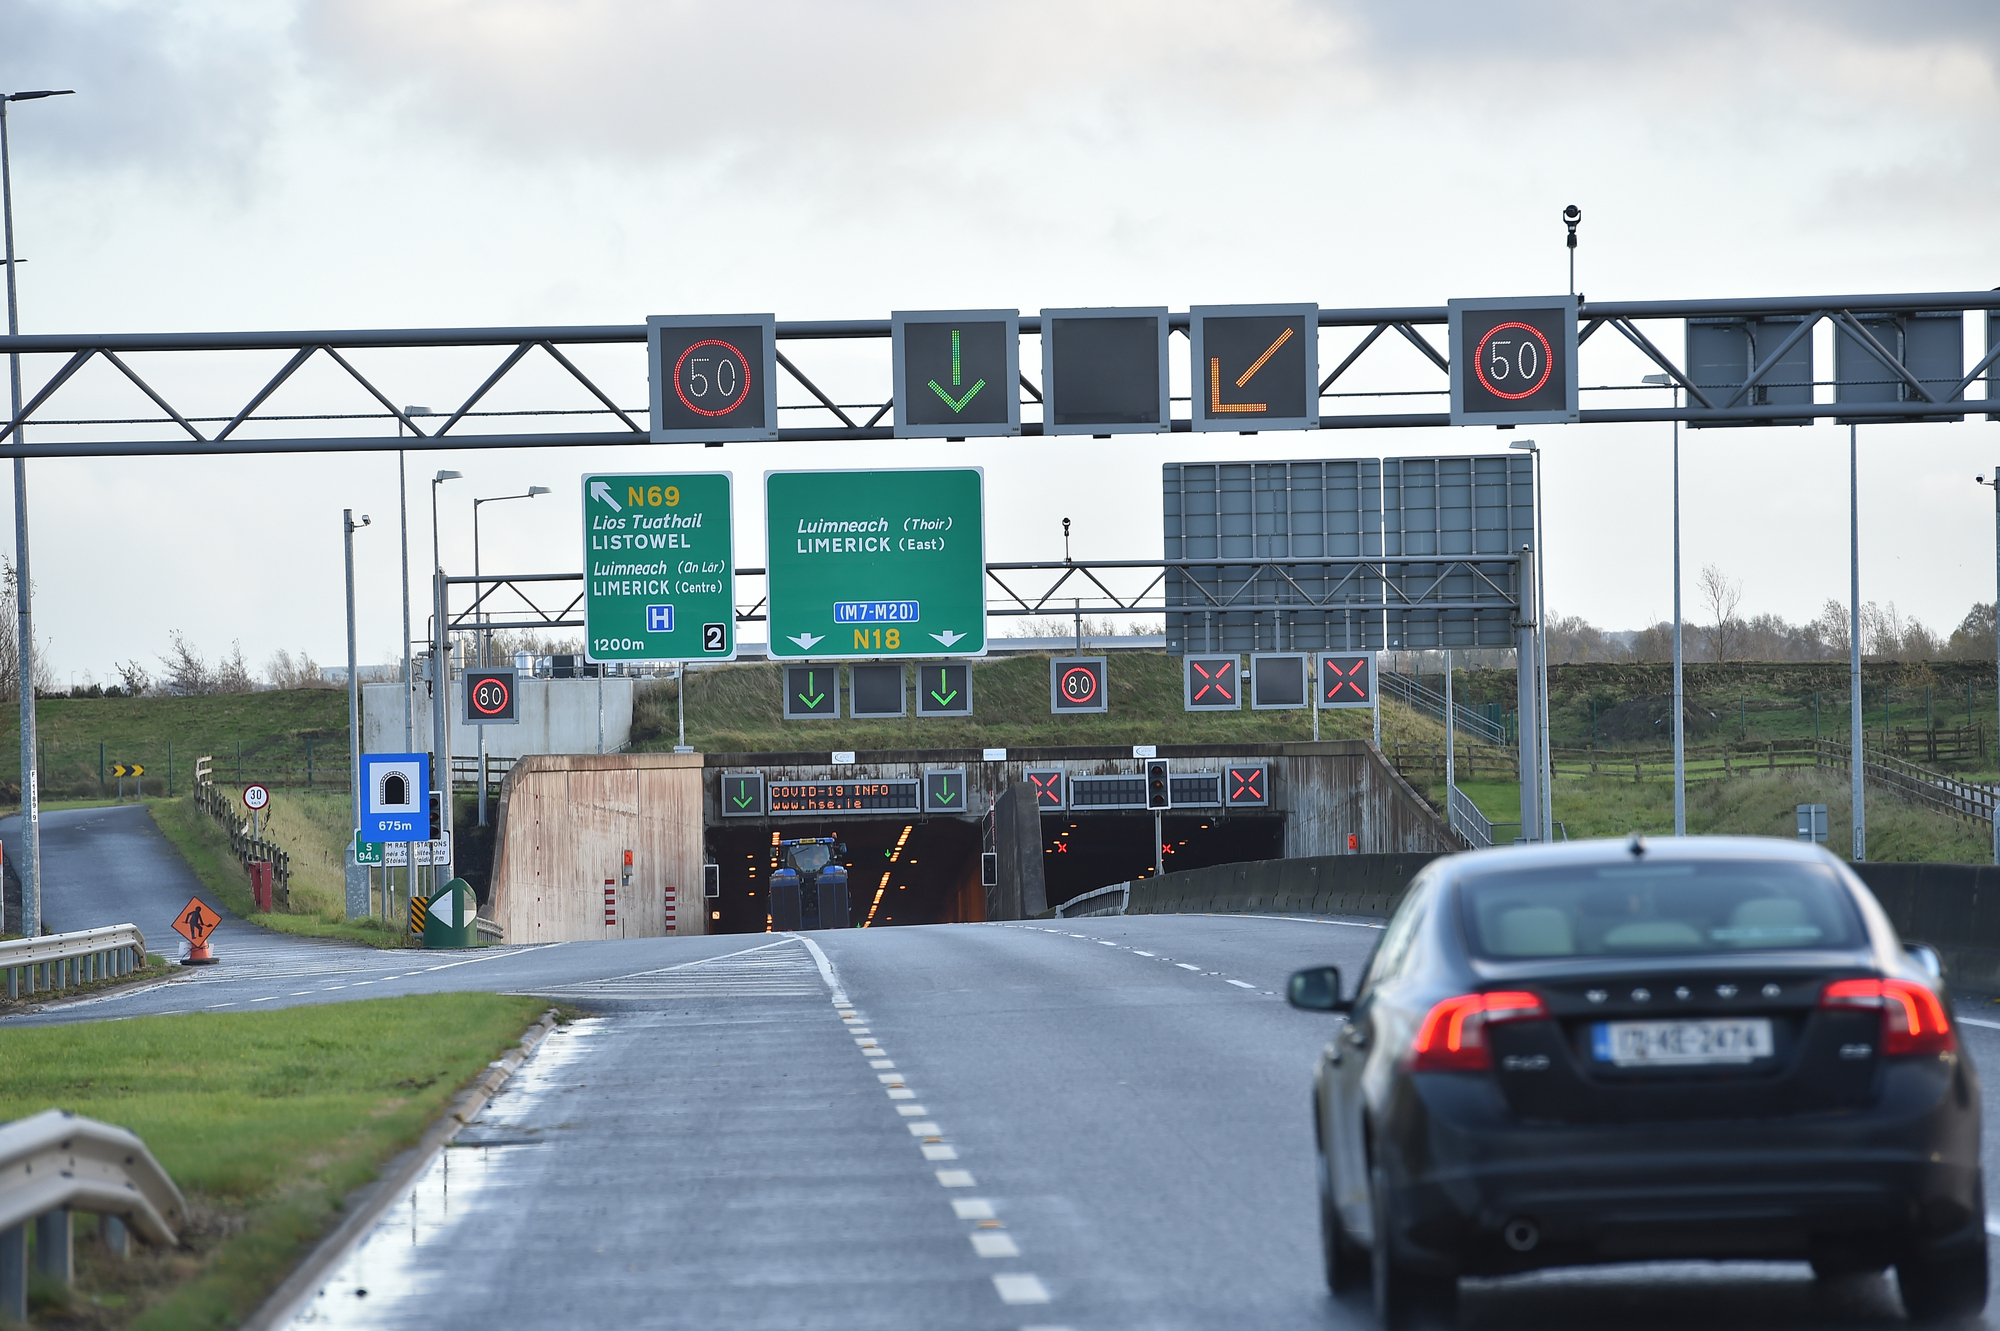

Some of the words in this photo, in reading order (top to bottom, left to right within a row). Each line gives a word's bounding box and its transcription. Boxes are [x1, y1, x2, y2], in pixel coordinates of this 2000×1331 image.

[1490, 341, 1537, 380] 50
[690, 358, 735, 397] 50
[628, 485, 680, 507] N69
[593, 514, 627, 530] Lios
[632, 512, 703, 530] Tuathail
[797, 517, 889, 534] Luimneach
[903, 516, 954, 532] (Thoir)
[592, 533, 691, 550] LISTOWEL
[797, 536, 891, 554] LIMERICK
[898, 536, 946, 552] (East)
[593, 560, 668, 577] Luimneach
[593, 580, 670, 597] LIMERICK
[675, 579, 723, 595] (Centre)
[651, 608, 670, 629] H
[839, 603, 915, 621] (M7-M20)
[593, 638, 645, 652] 1200m
[707, 627, 722, 648] 2
[853, 628, 901, 650] N18
[1068, 676, 1091, 695] 80
[480, 687, 501, 706] 80
[250, 789, 262, 800] 30
[772, 785, 845, 798] COVID-19
[854, 784, 890, 796] INFO
[772, 798, 863, 811] www.hse.ie
[378, 820, 412, 831] 675m
[366, 842, 373, 851] S
